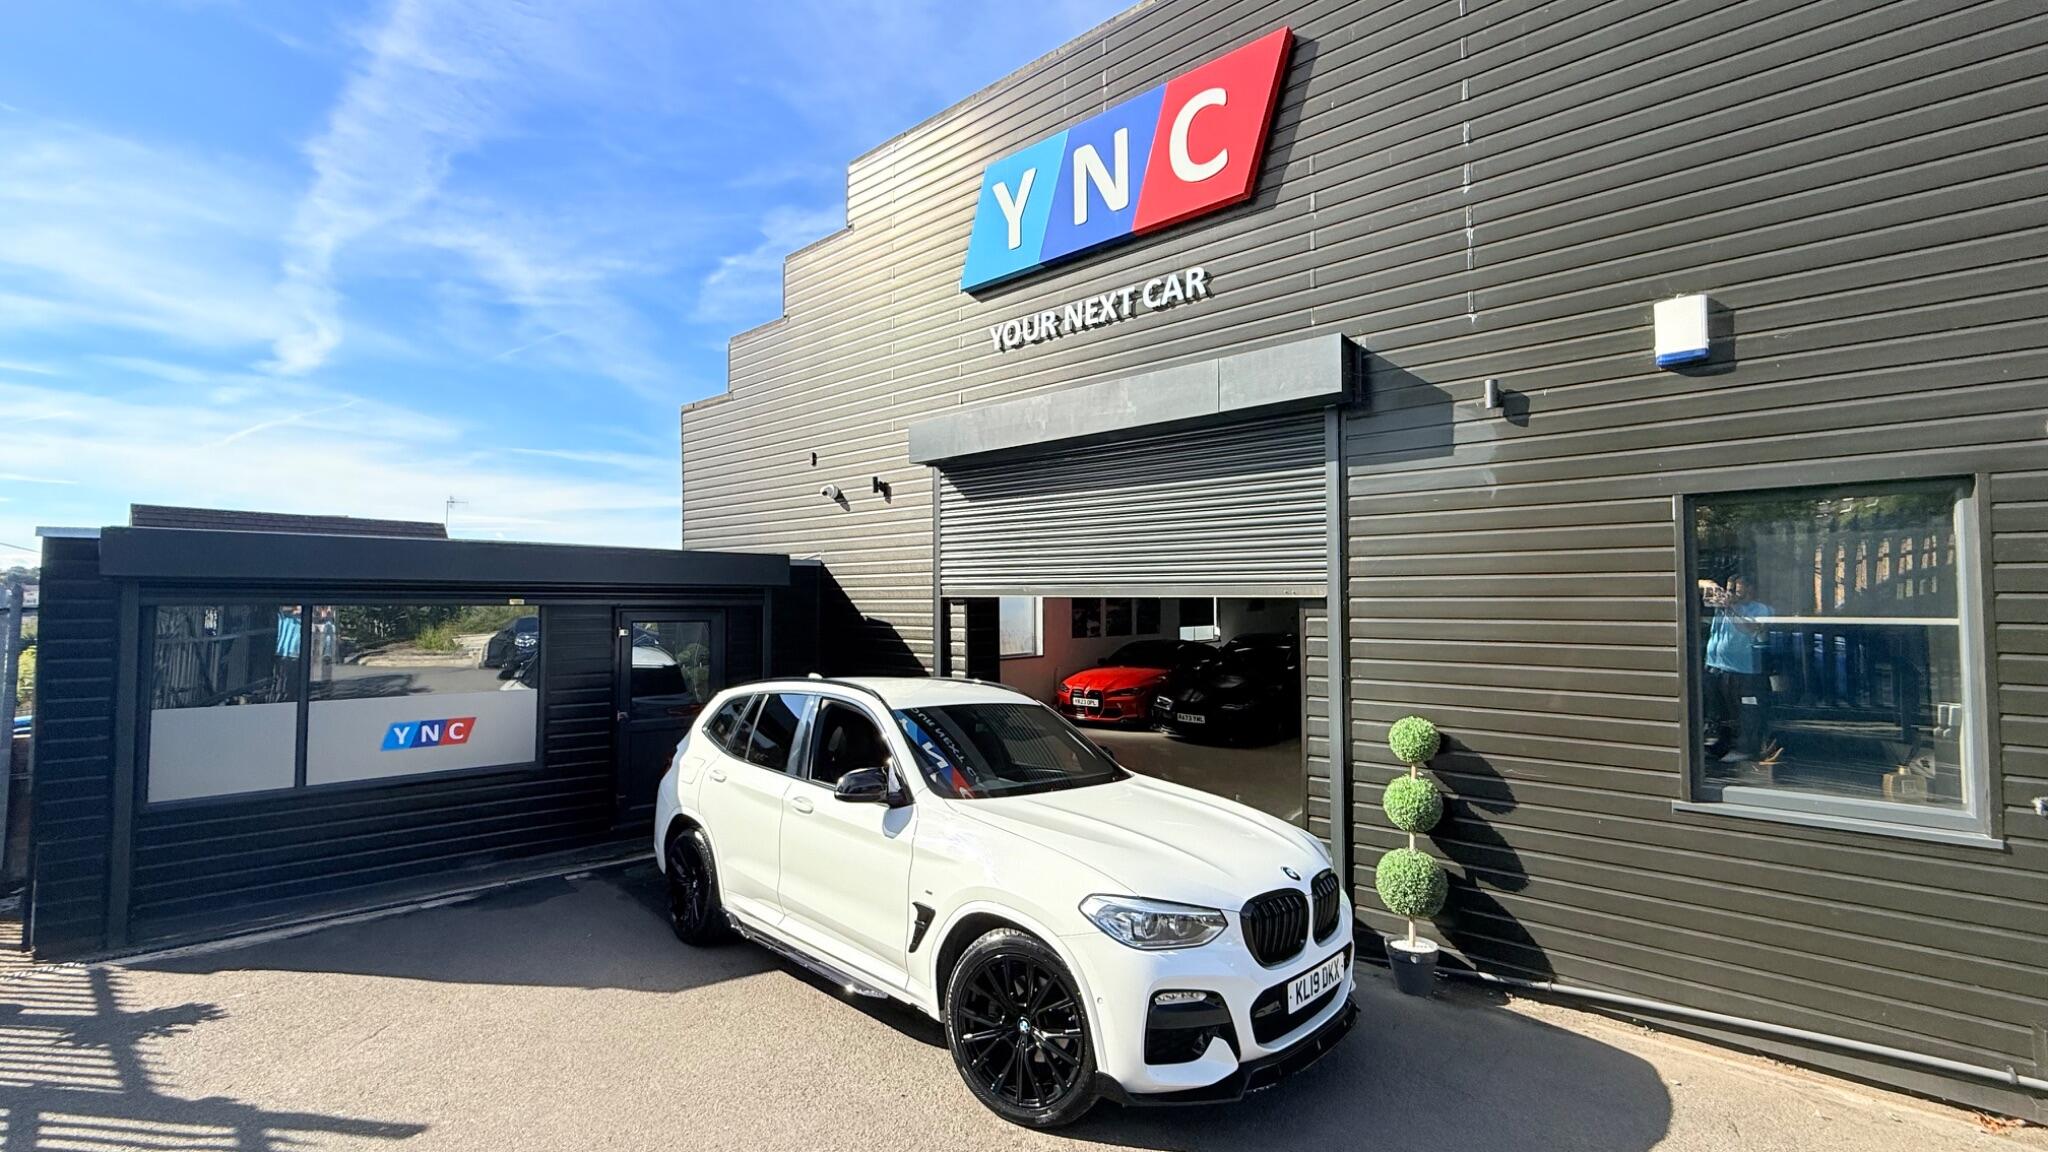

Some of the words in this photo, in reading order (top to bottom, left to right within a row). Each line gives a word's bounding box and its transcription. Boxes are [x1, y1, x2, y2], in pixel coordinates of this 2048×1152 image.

[992, 87, 1229, 250] YNC
[989, 311, 1058, 351] YOUR
[1064, 287, 1136, 331] NEXT
[1143, 266, 1208, 308] CAR
[393, 722, 465, 745] YNC
[1295, 971, 1320, 1005] KL19
[1322, 957, 1340, 989] DKX
